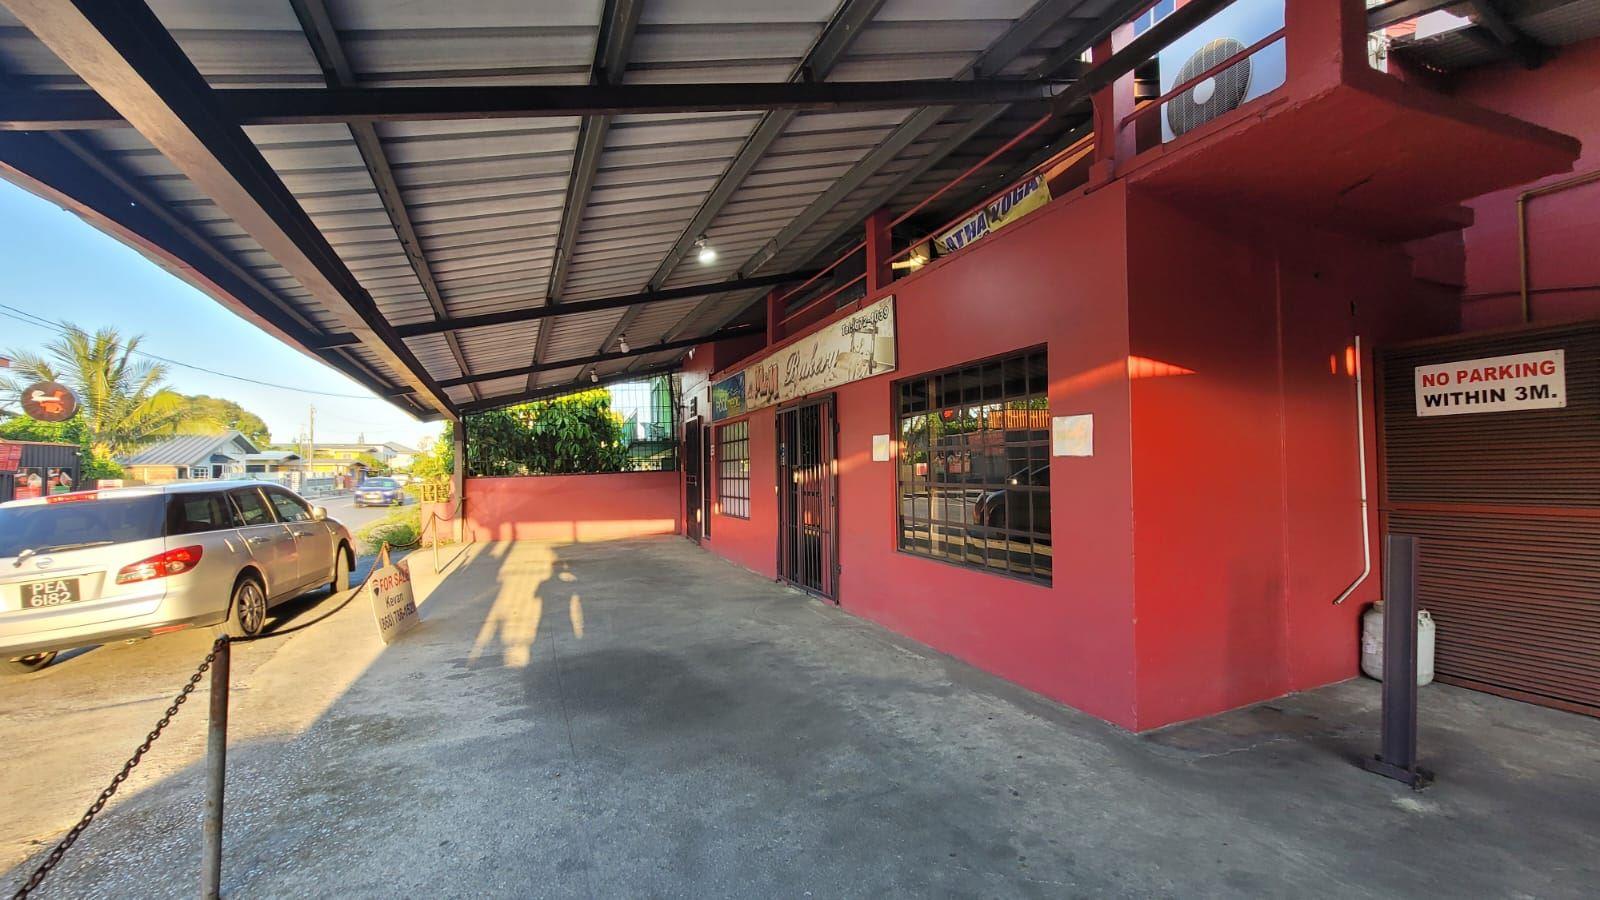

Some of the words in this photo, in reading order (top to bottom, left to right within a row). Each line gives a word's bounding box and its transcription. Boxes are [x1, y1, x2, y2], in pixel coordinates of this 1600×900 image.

[1422, 372, 1450, 388] NO
[1456, 360, 1556, 385] PARKING
[1423, 388, 1506, 408] WITHIN
[1514, 384, 1558, 401] 3M.
[31, 581, 68, 596] PEA
[380, 575, 393, 592] FOR
[30, 592, 71, 607] 6182
[386, 592, 404, 609] Kevan
